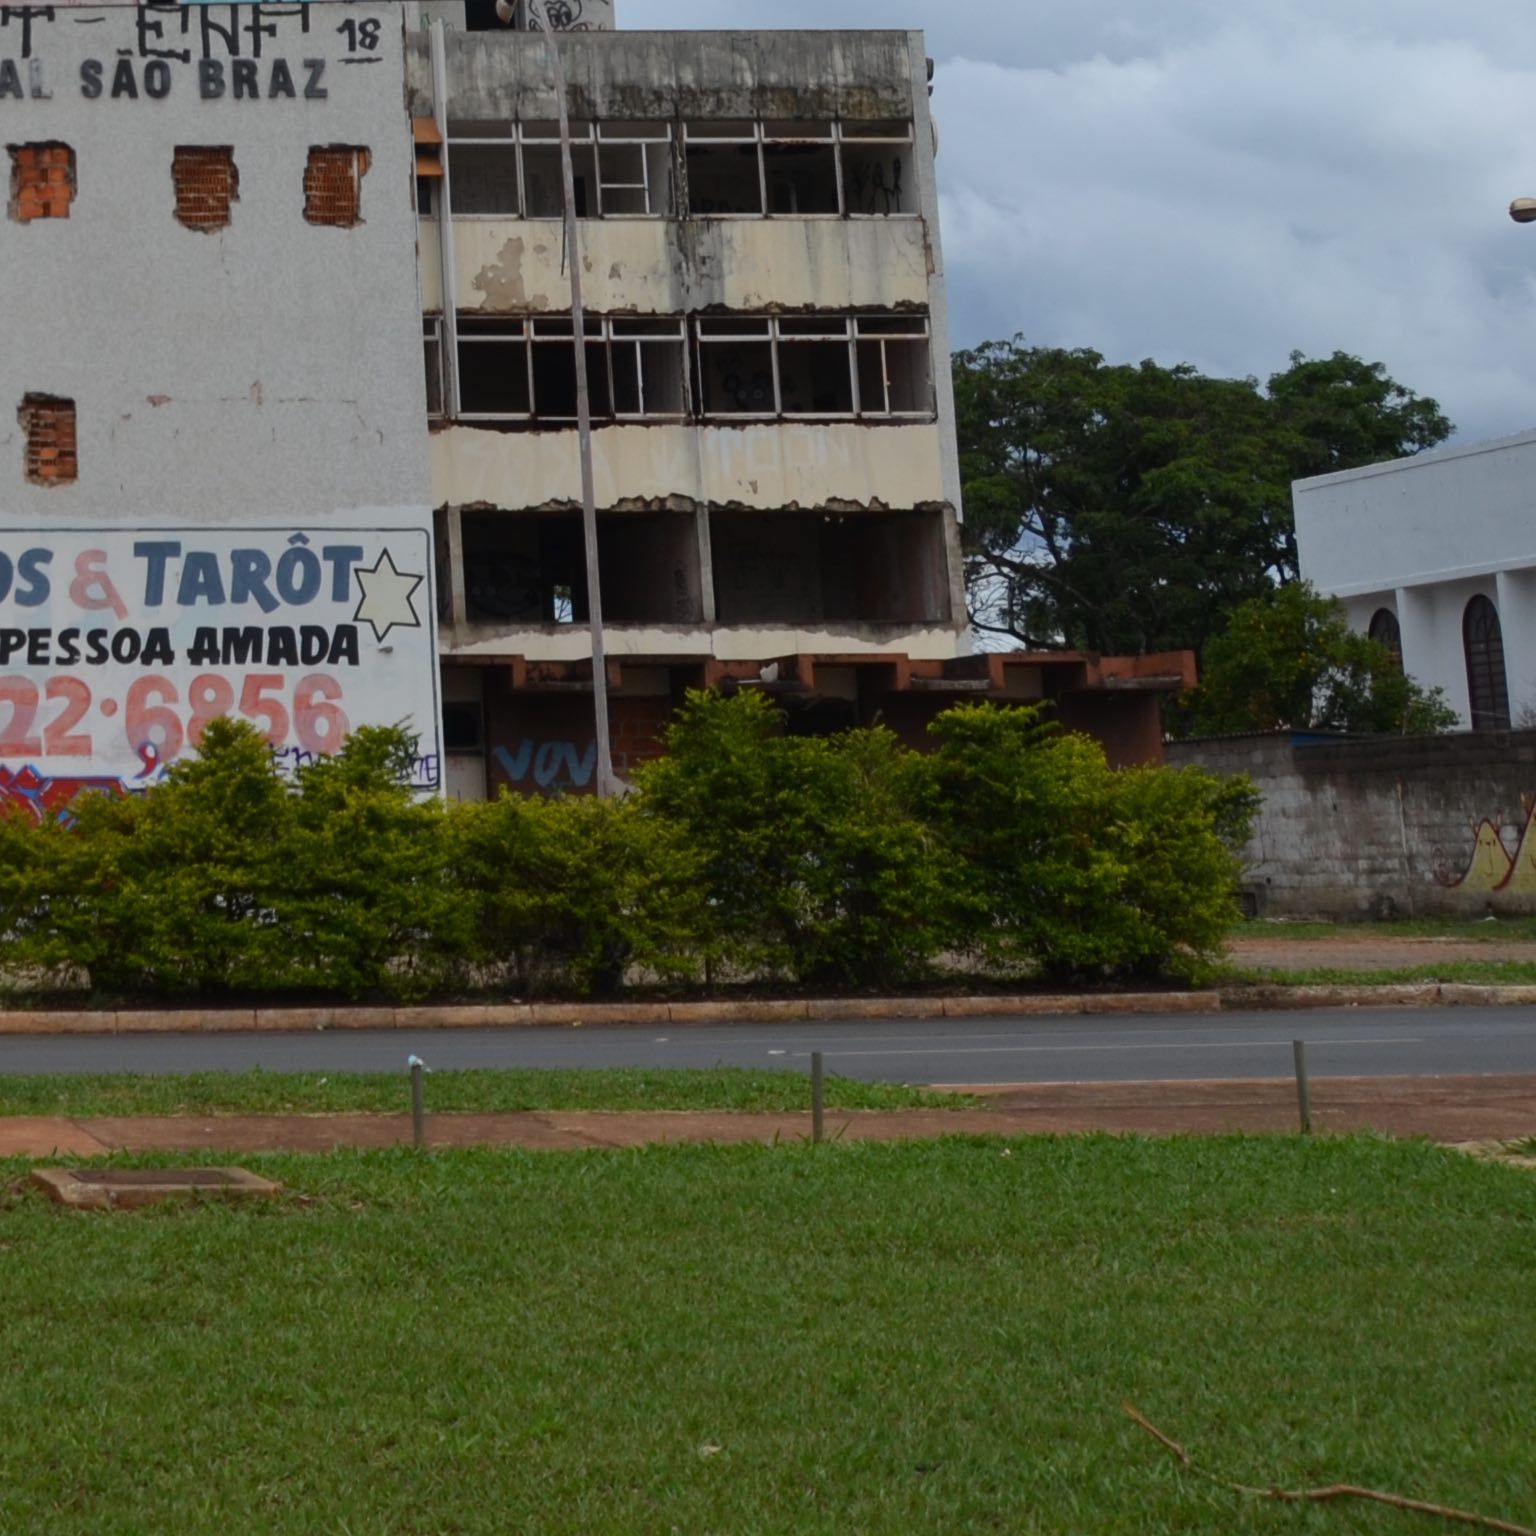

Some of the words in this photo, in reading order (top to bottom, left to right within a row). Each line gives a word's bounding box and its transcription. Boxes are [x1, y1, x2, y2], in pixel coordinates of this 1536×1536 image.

[336, 18, 384, 53] 18
[81, 49, 173, 100] SÃO
[199, 58, 329, 100] BRAZ
[68, 549, 129, 621] &
[132, 531, 364, 614] TARÔT
[186, 624, 361, 666] AMADA
